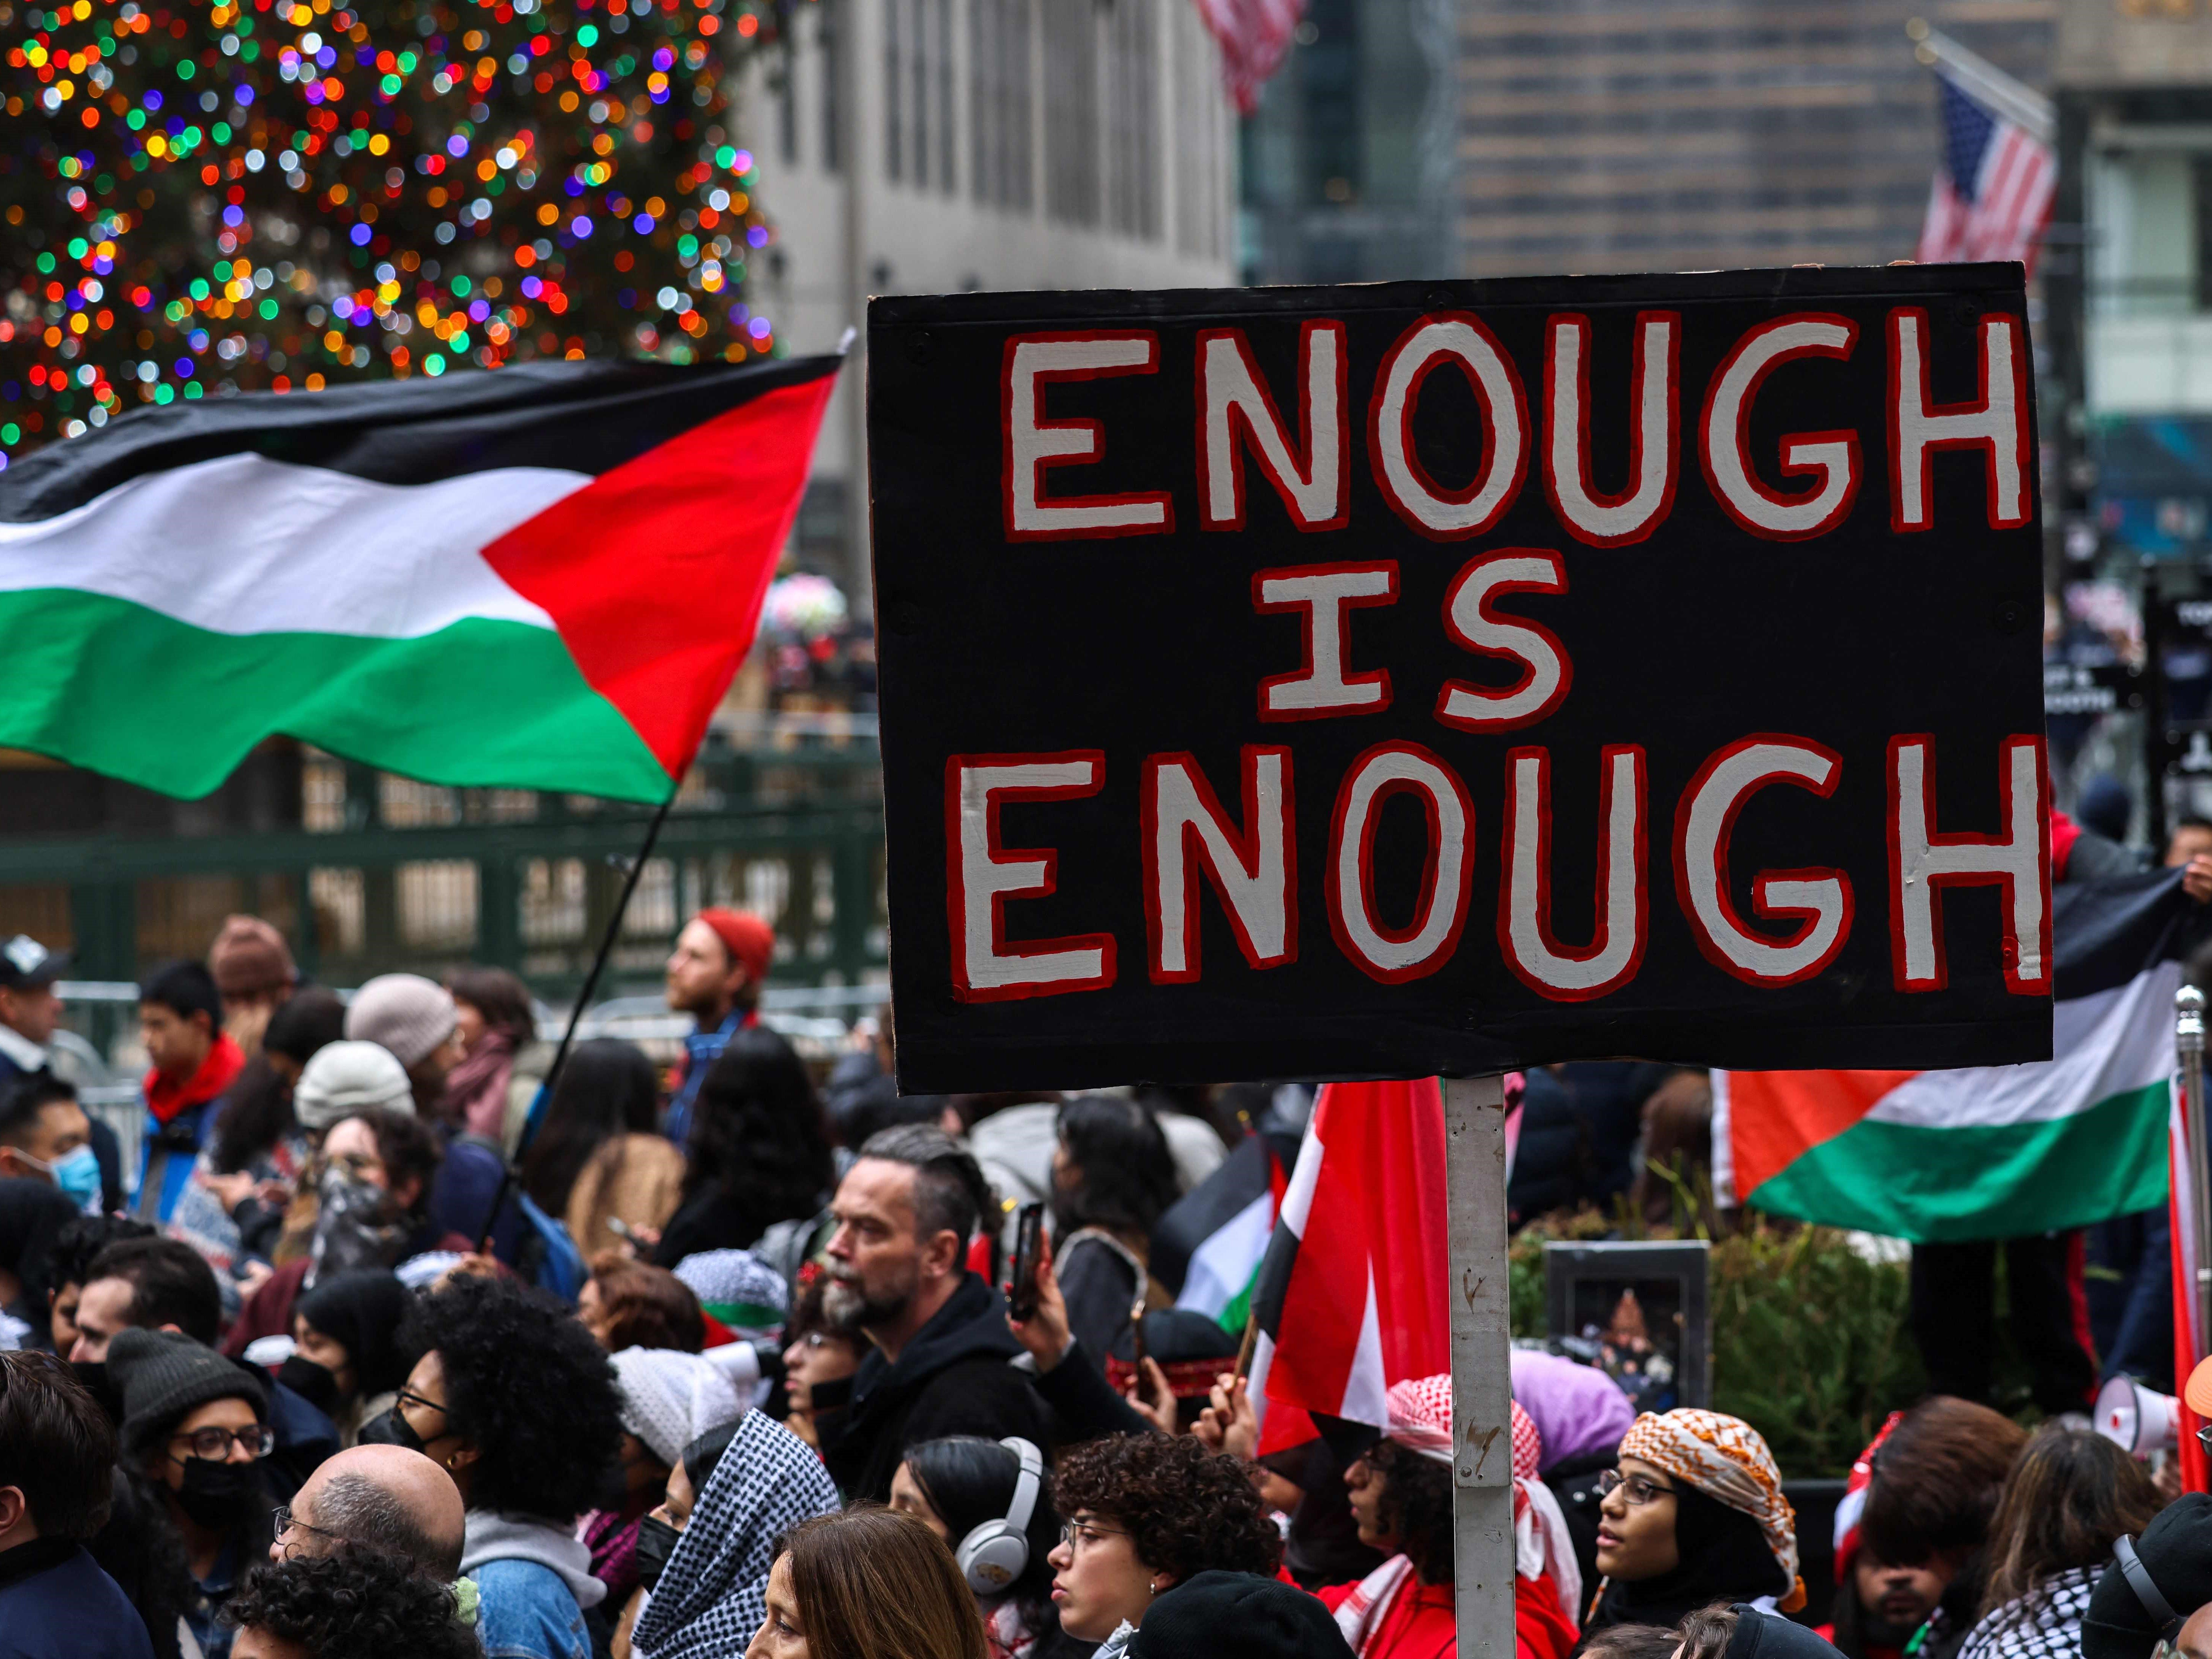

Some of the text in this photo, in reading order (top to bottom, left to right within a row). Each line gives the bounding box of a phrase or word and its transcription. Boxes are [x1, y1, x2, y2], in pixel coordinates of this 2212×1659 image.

[1003, 308, 2031, 547] ENOUGH
[1253, 548, 1572, 730] IS
[947, 734, 2052, 1003] ENOUGH
